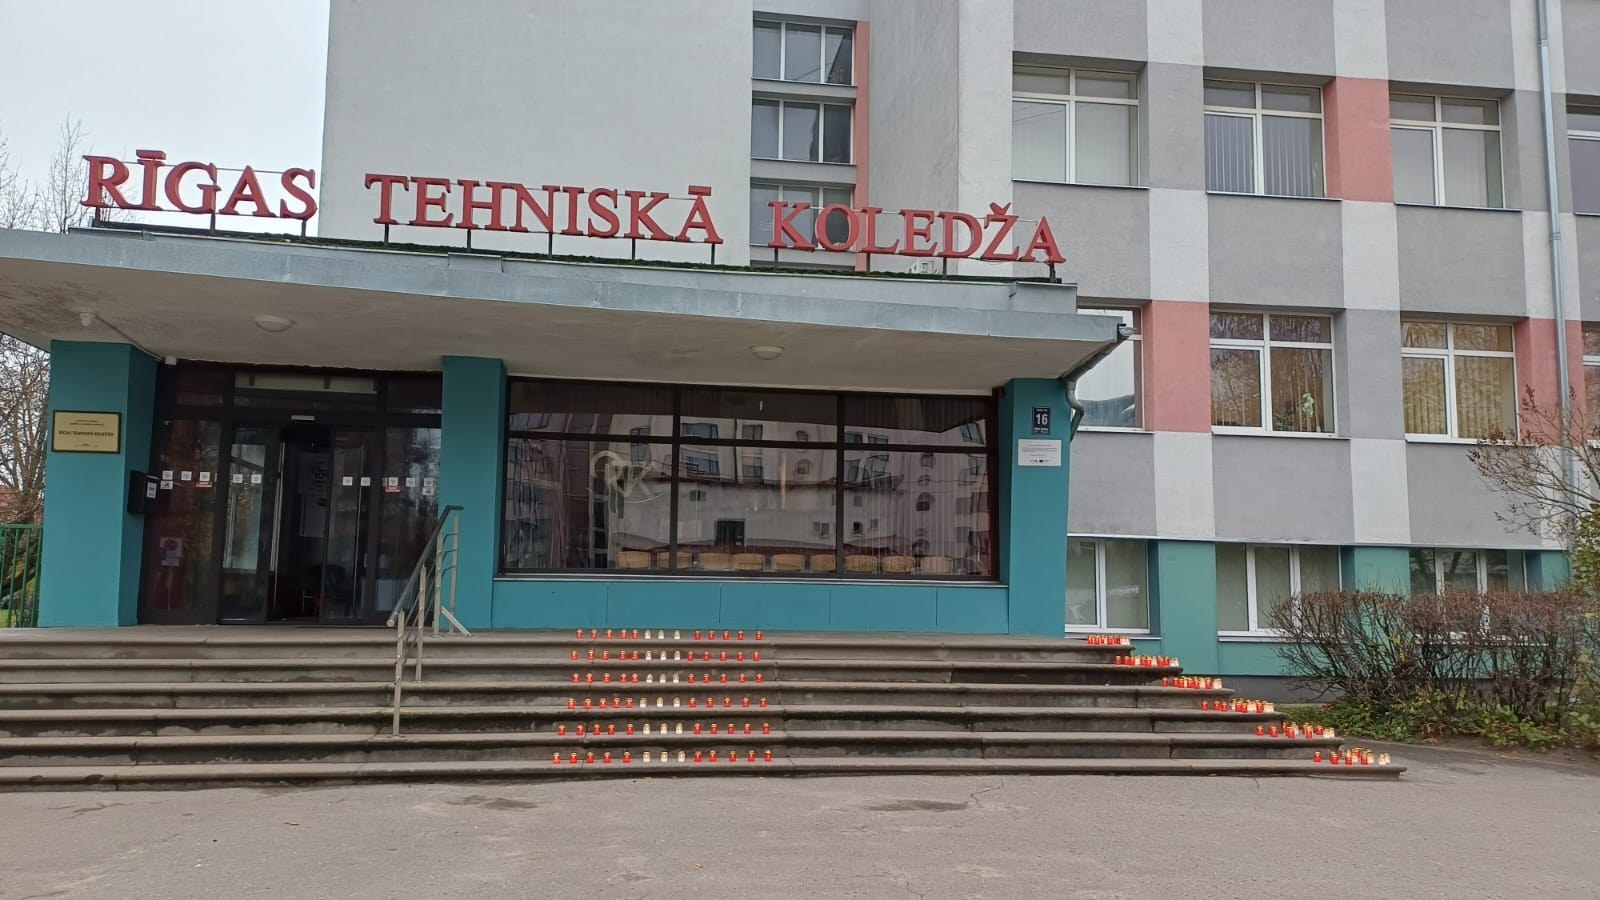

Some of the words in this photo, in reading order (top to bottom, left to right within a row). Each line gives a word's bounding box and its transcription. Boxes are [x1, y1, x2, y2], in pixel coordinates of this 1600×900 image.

[82, 149, 318, 220] RĪGAS
[365, 173, 724, 244] TEHNISKĀ
[768, 200, 1066, 263] KOLEDŽA
[1035, 413, 1048, 425] 16
